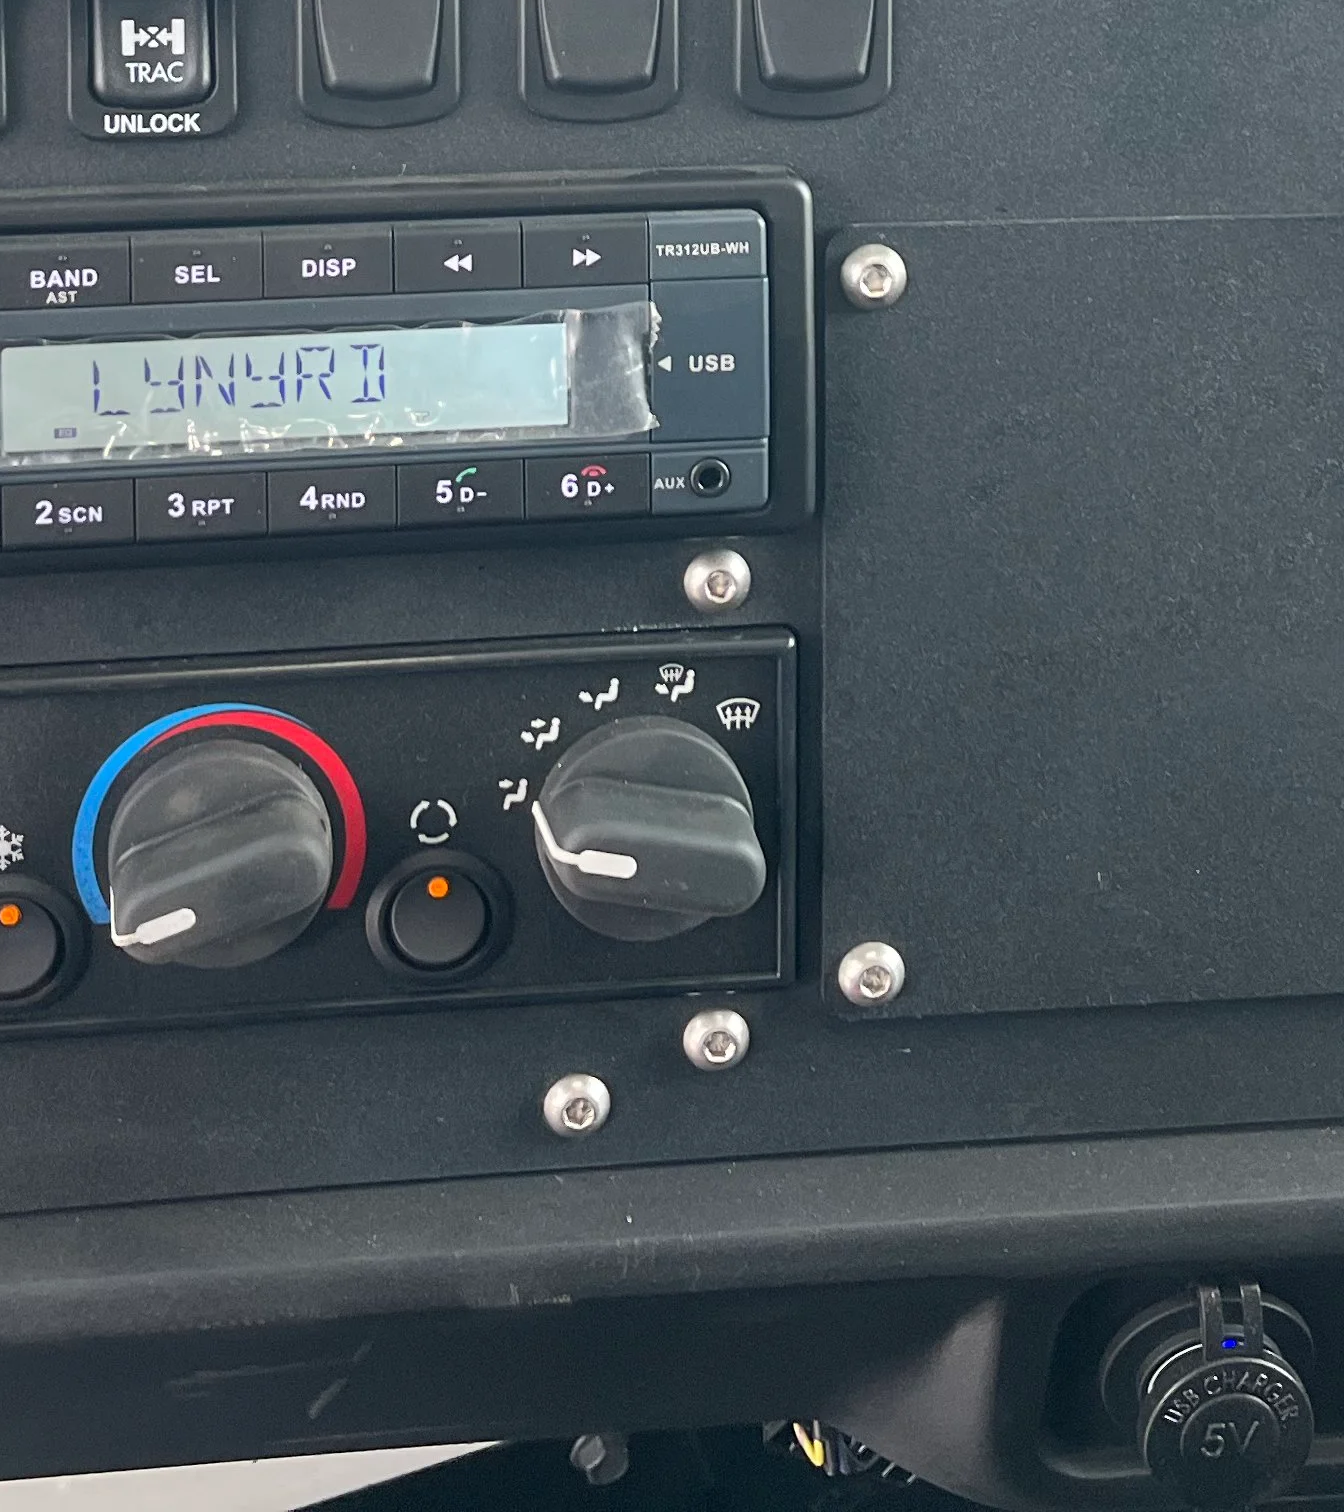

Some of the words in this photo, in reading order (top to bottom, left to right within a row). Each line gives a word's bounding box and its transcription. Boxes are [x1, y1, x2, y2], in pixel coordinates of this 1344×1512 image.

[124, 61, 184, 83] TRAC
[102, 112, 202, 135] UNLOCK
[655, 241, 750, 257] TR312UB-WH
[29, 268, 99, 289] BAND
[173, 264, 222, 285] SEL
[300, 257, 357, 279] DISP
[45, 290, 78, 305] AST
[687, 353, 736, 373] USB
[435, 479, 453, 504] 5
[560, 473, 579, 498] 6
[653, 475, 686, 490] AUX
[34, 499, 54, 526] 2
[58, 505, 104, 525] SCN
[167, 492, 187, 519] 3
[191, 498, 235, 517] RPT
[1163, 1388, 1201, 1425] USB
[1203, 1368, 1300, 1422] CHARGER
[1200, 1420, 1260, 1459] 5V
